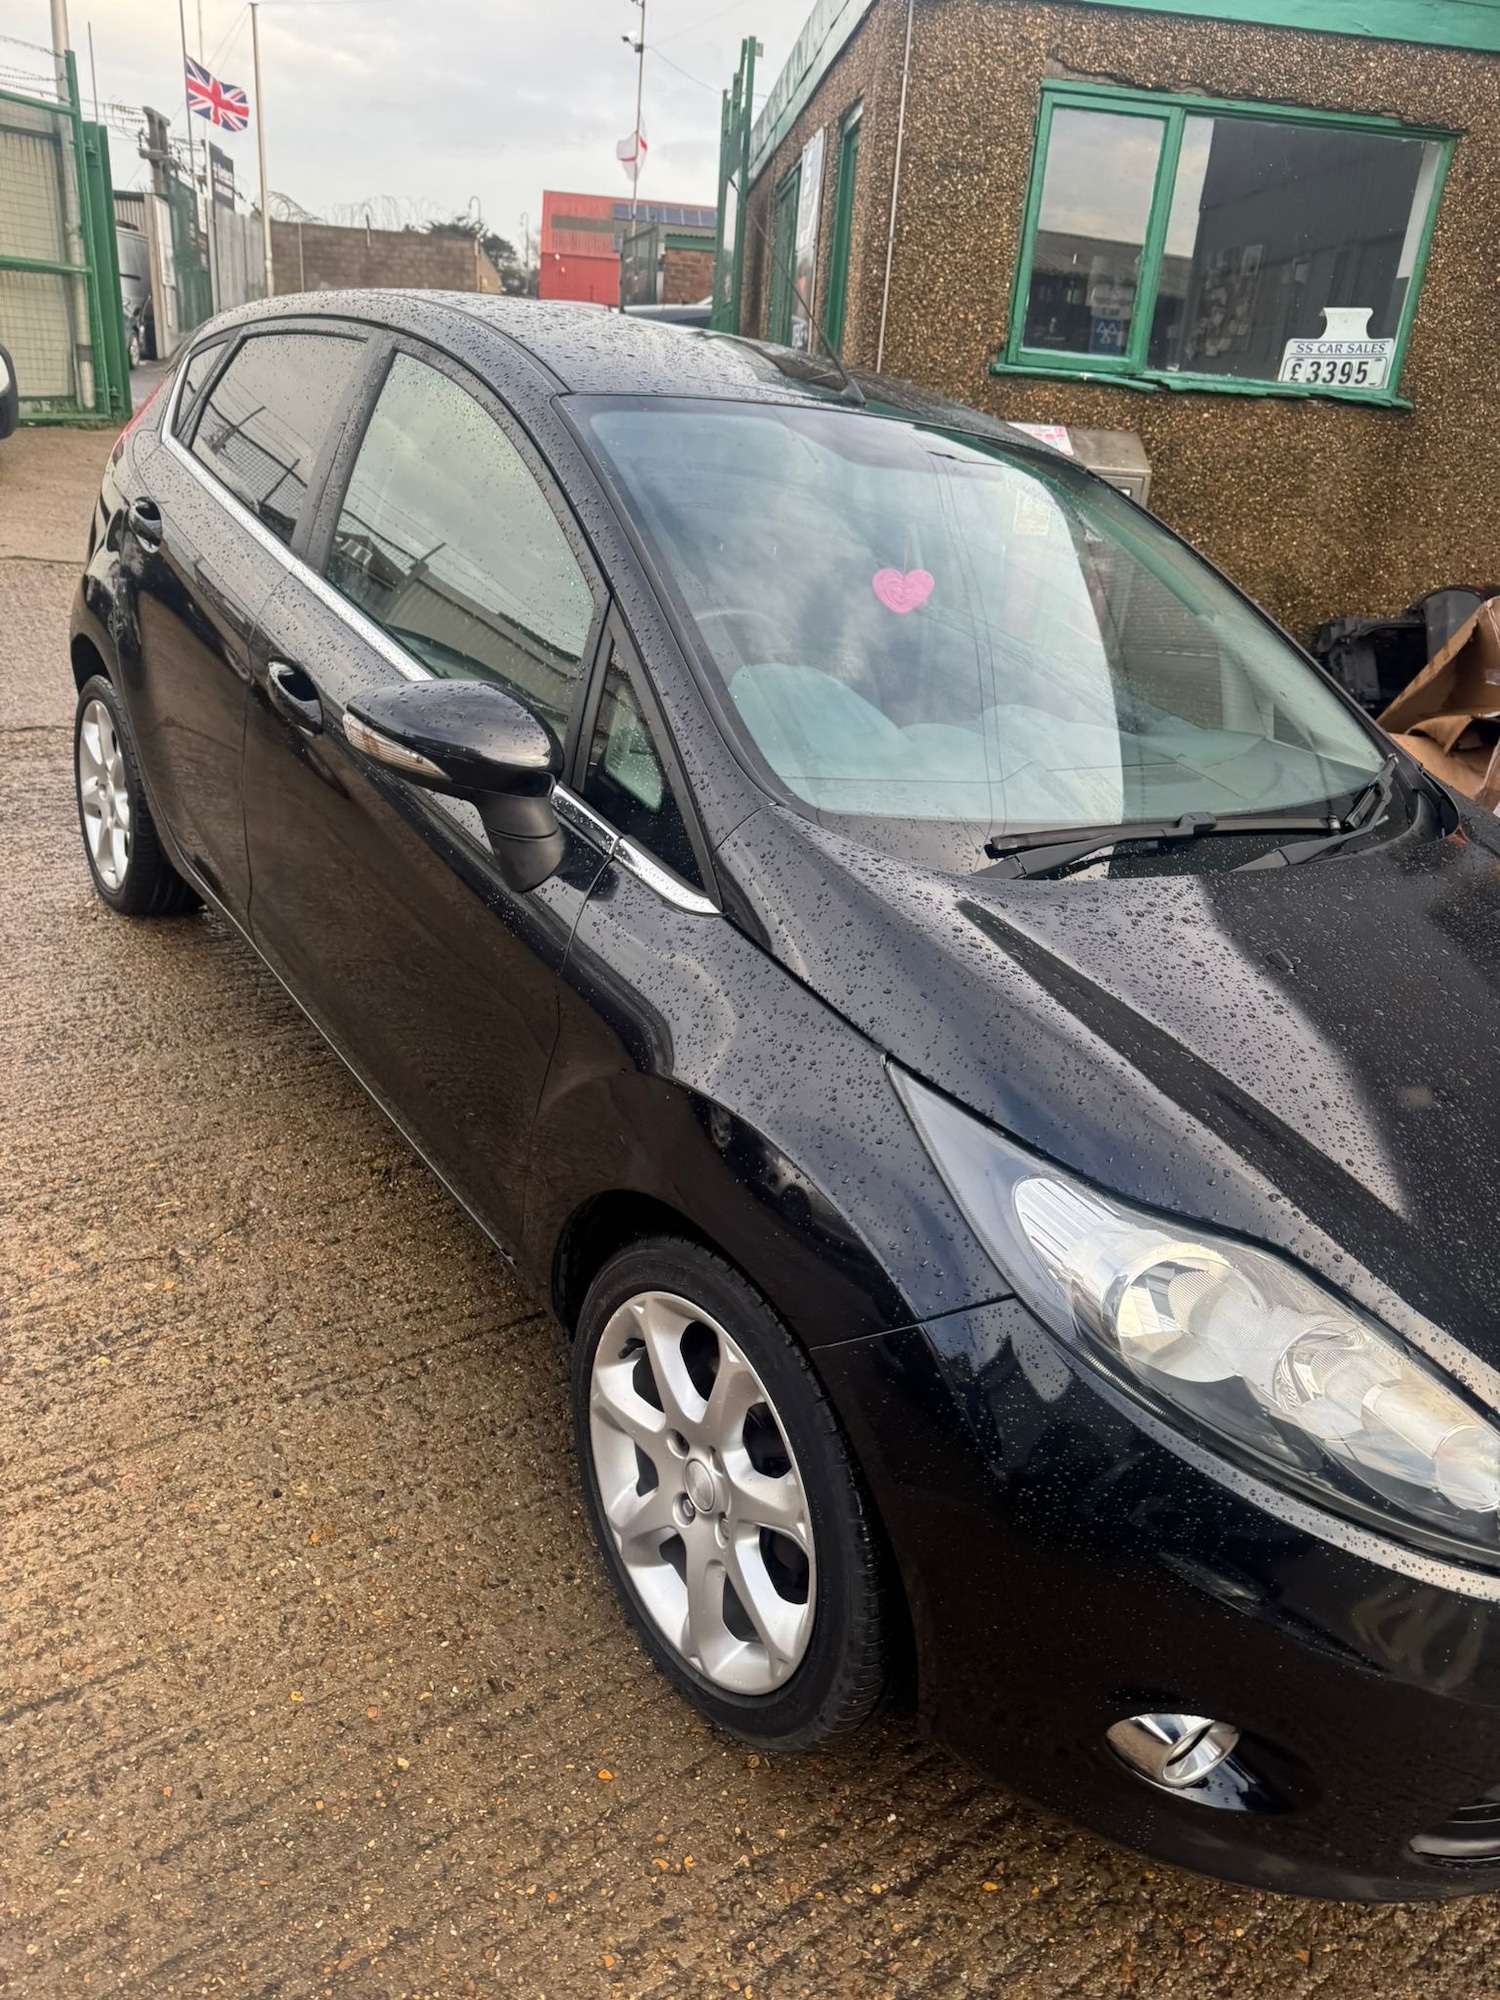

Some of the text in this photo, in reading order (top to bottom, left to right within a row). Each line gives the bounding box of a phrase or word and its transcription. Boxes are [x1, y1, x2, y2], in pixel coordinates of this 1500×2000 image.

[1296, 343, 1386, 354] SS CAR SALES
[1290, 361, 1369, 384] £3395
